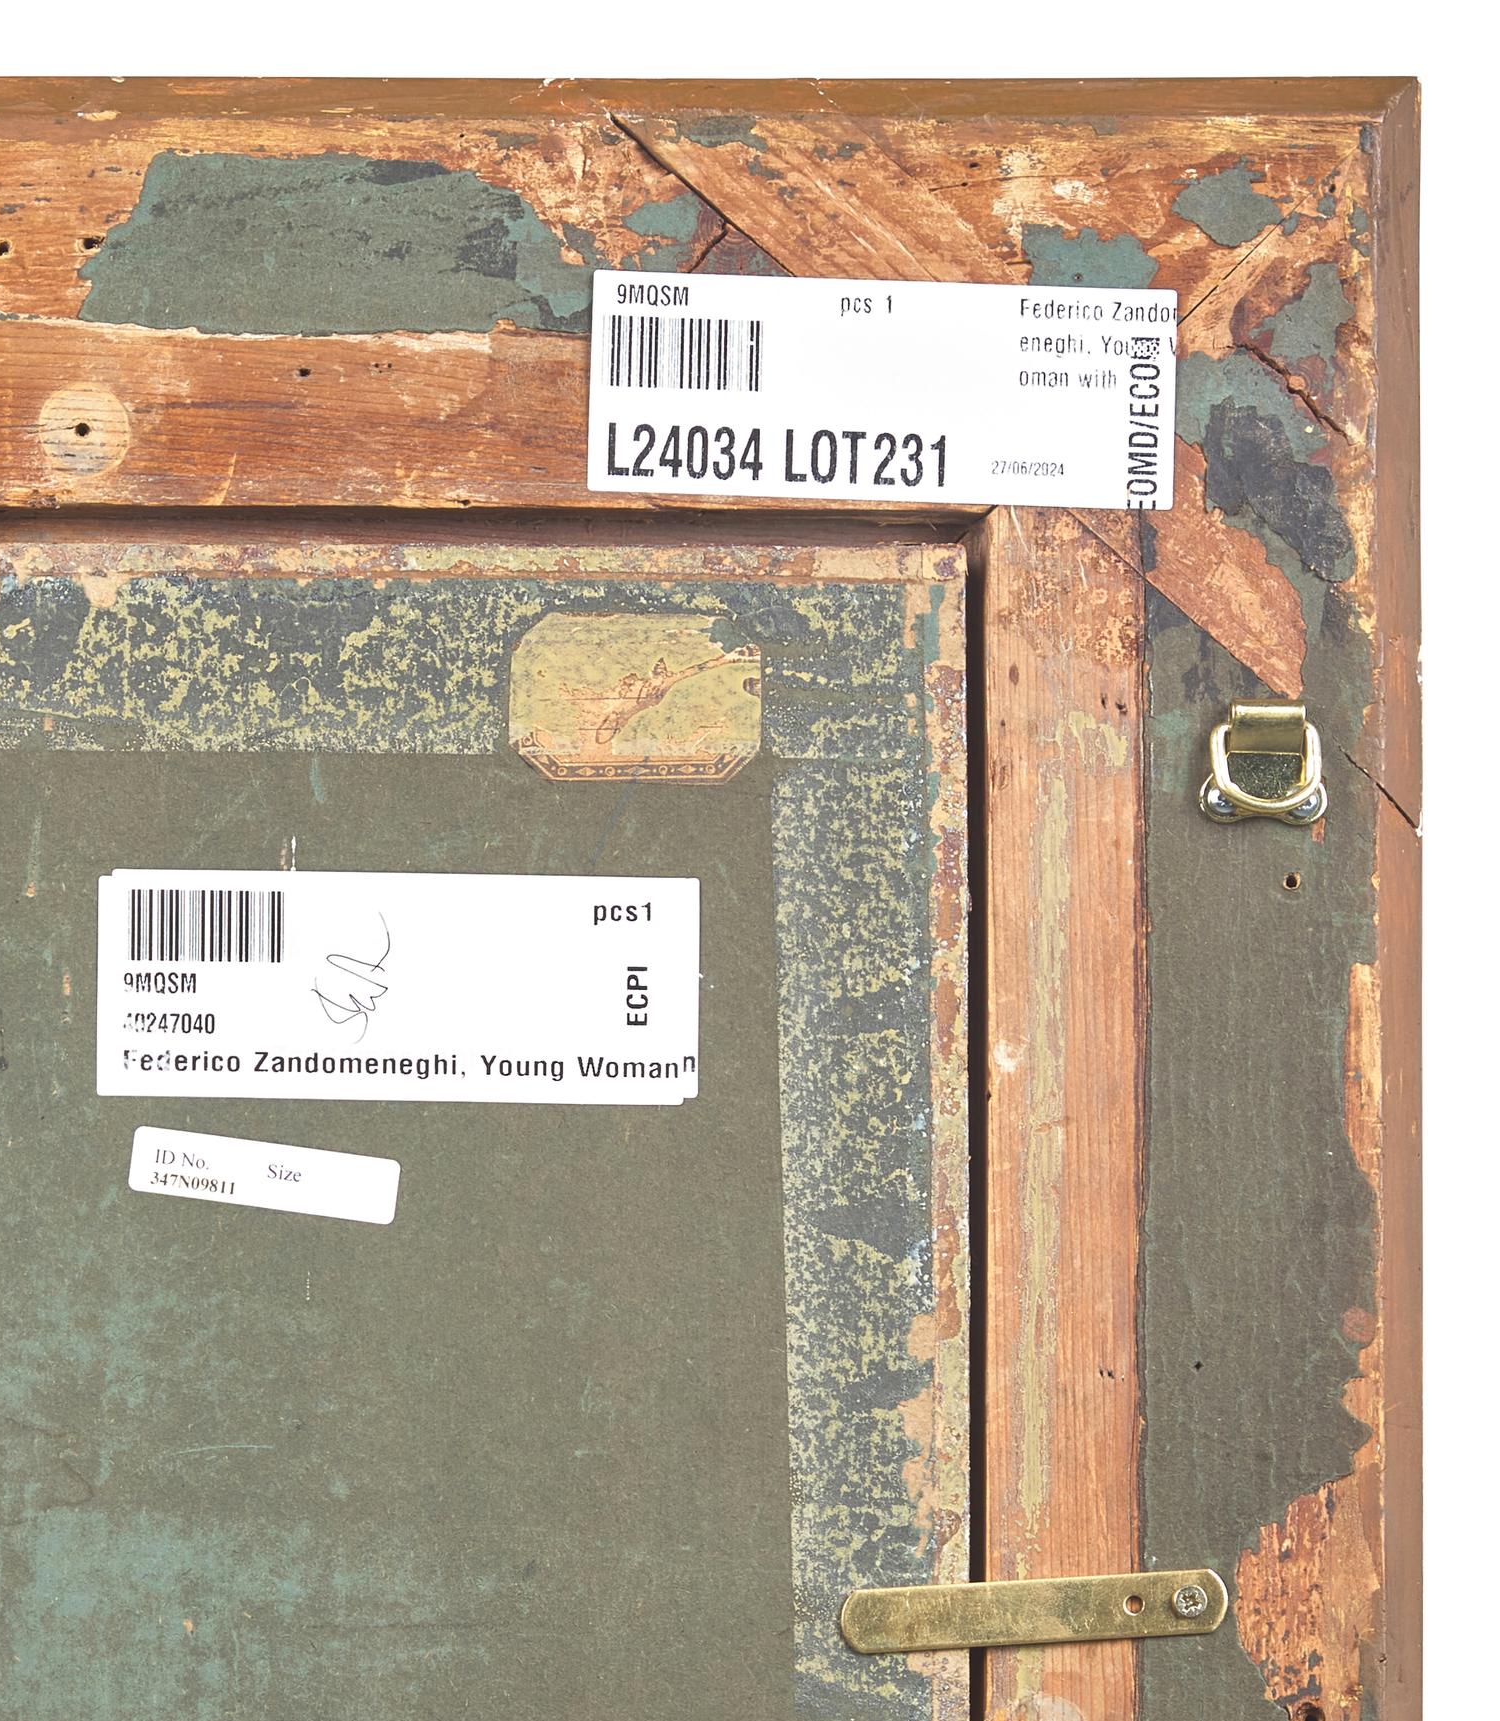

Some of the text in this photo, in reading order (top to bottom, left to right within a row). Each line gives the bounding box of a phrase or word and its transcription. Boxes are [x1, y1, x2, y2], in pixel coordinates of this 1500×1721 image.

[616, 283, 689, 307] 9MQSM
[840, 295, 872, 316] pcs
[886, 294, 893, 315] 1
[1020, 298, 1103, 322] Federico
[1018, 369, 1117, 390] oman with
[607, 422, 764, 481] L24034
[785, 428, 947, 489] LOT231
[593, 903, 652, 924] pcs1
[123, 972, 197, 994] 9MQSM
[626, 965, 648, 1025] ECPI
[253, 1051, 467, 1079] Zandomeneghi,
[481, 1055, 565, 1081] Young
[155, 1149, 302, 1182] ID No. Size
